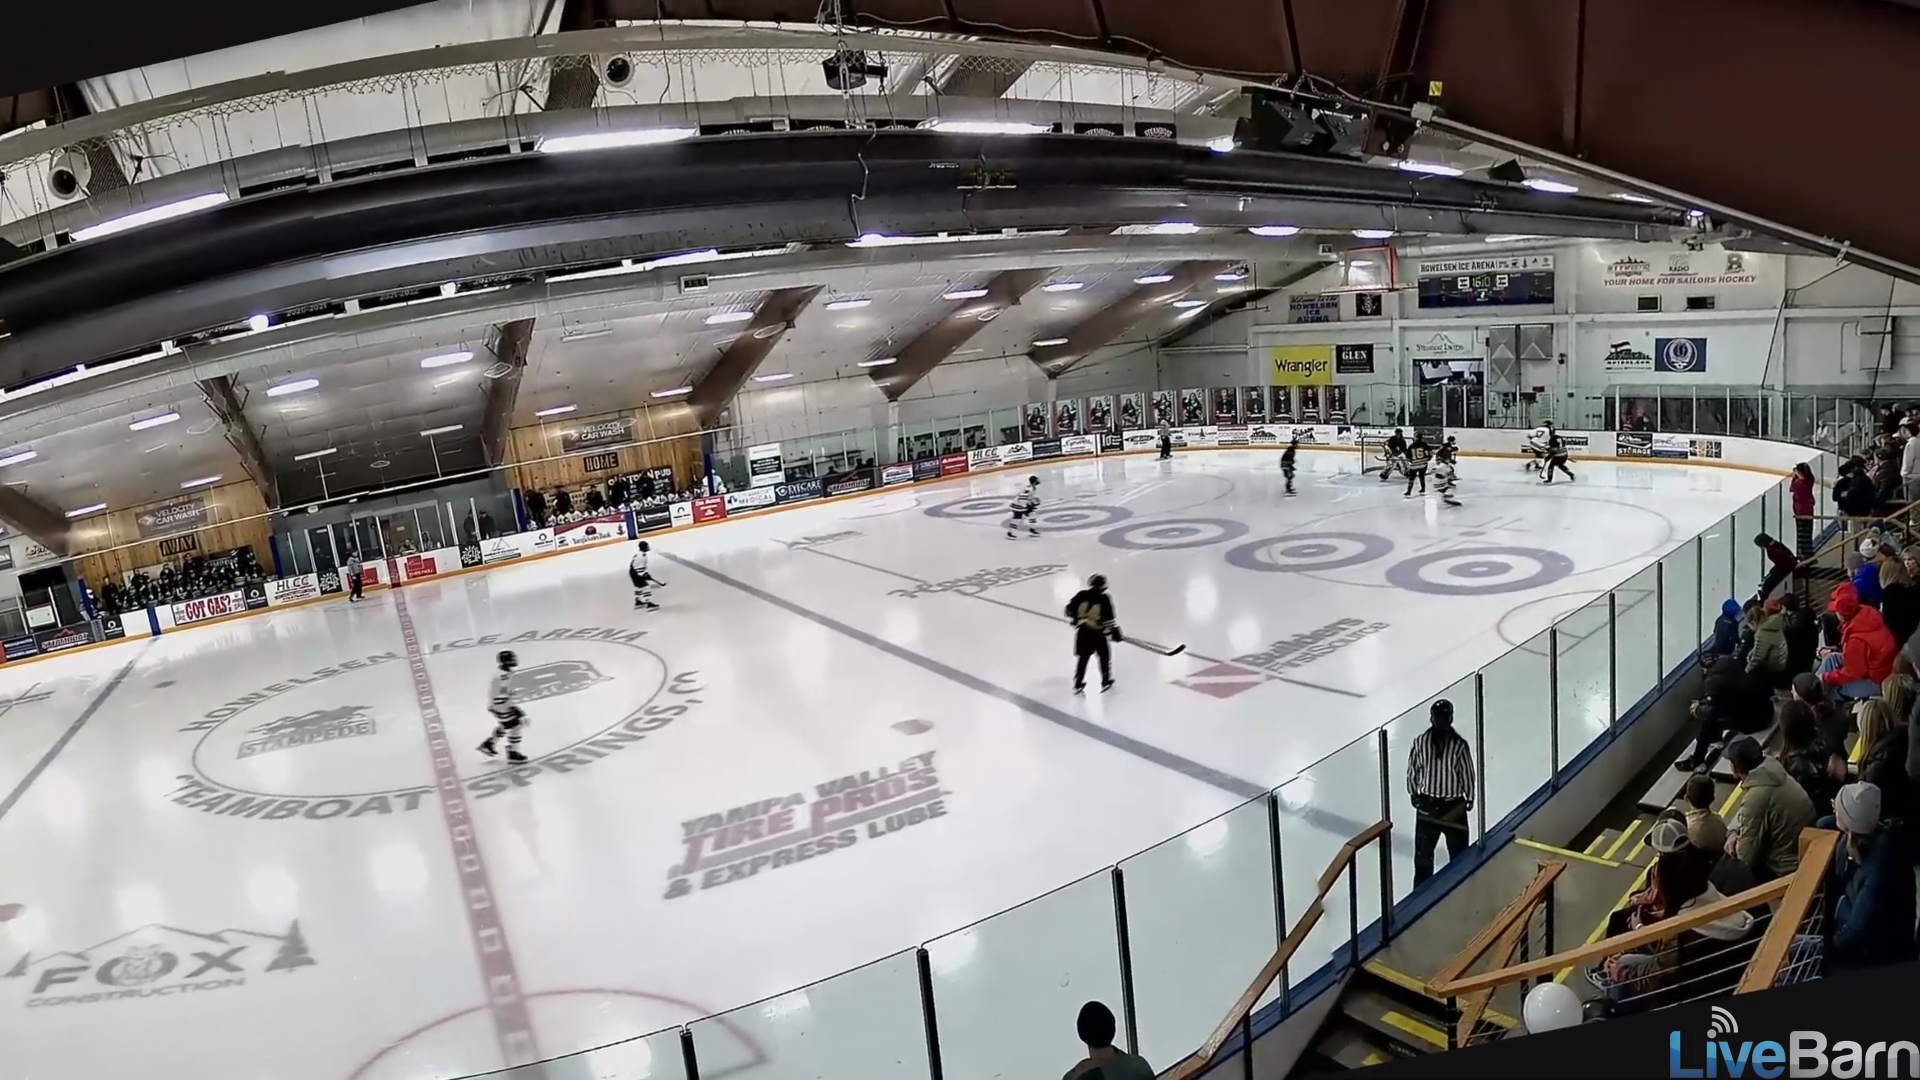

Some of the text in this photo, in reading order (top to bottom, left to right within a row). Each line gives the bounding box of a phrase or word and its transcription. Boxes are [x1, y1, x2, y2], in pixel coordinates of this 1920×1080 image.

[1421, 260, 1495, 273] HOWELSEN ICE ARENA
[1604, 279, 1627, 287] YOUR
[1629, 278, 1655, 286] HOME
[1676, 277, 1716, 285] SAILORS
[1718, 275, 1756, 284] HOCKEY
[1342, 351, 1367, 360] GLEN
[1275, 358, 1328, 378] Wrangler
[581, 427, 625, 441] CAR WASH
[582, 420, 620, 433] VELOCITY
[586, 453, 617, 471] HOME
[155, 503, 195, 517] VELOCITY
[156, 510, 200, 525] CAR WASH
[162, 535, 194, 556] AWAY
[185, 600, 206, 621] GOT
[207, 595, 232, 616] GAS?
[178, 651, 398, 733] HOWELSEN
[509, 627, 649, 644] ARENA
[241, 721, 370, 755] STAMPEDE
[681, 751, 937, 836] YAMPA VALLEY
[682, 766, 941, 875] TIRE PROS
[700, 829, 857, 890] EXPRESS
[867, 800, 949, 839] LUBE
[33, 946, 248, 994] FOX
[25, 977, 247, 1007] CONSTRUCTION
